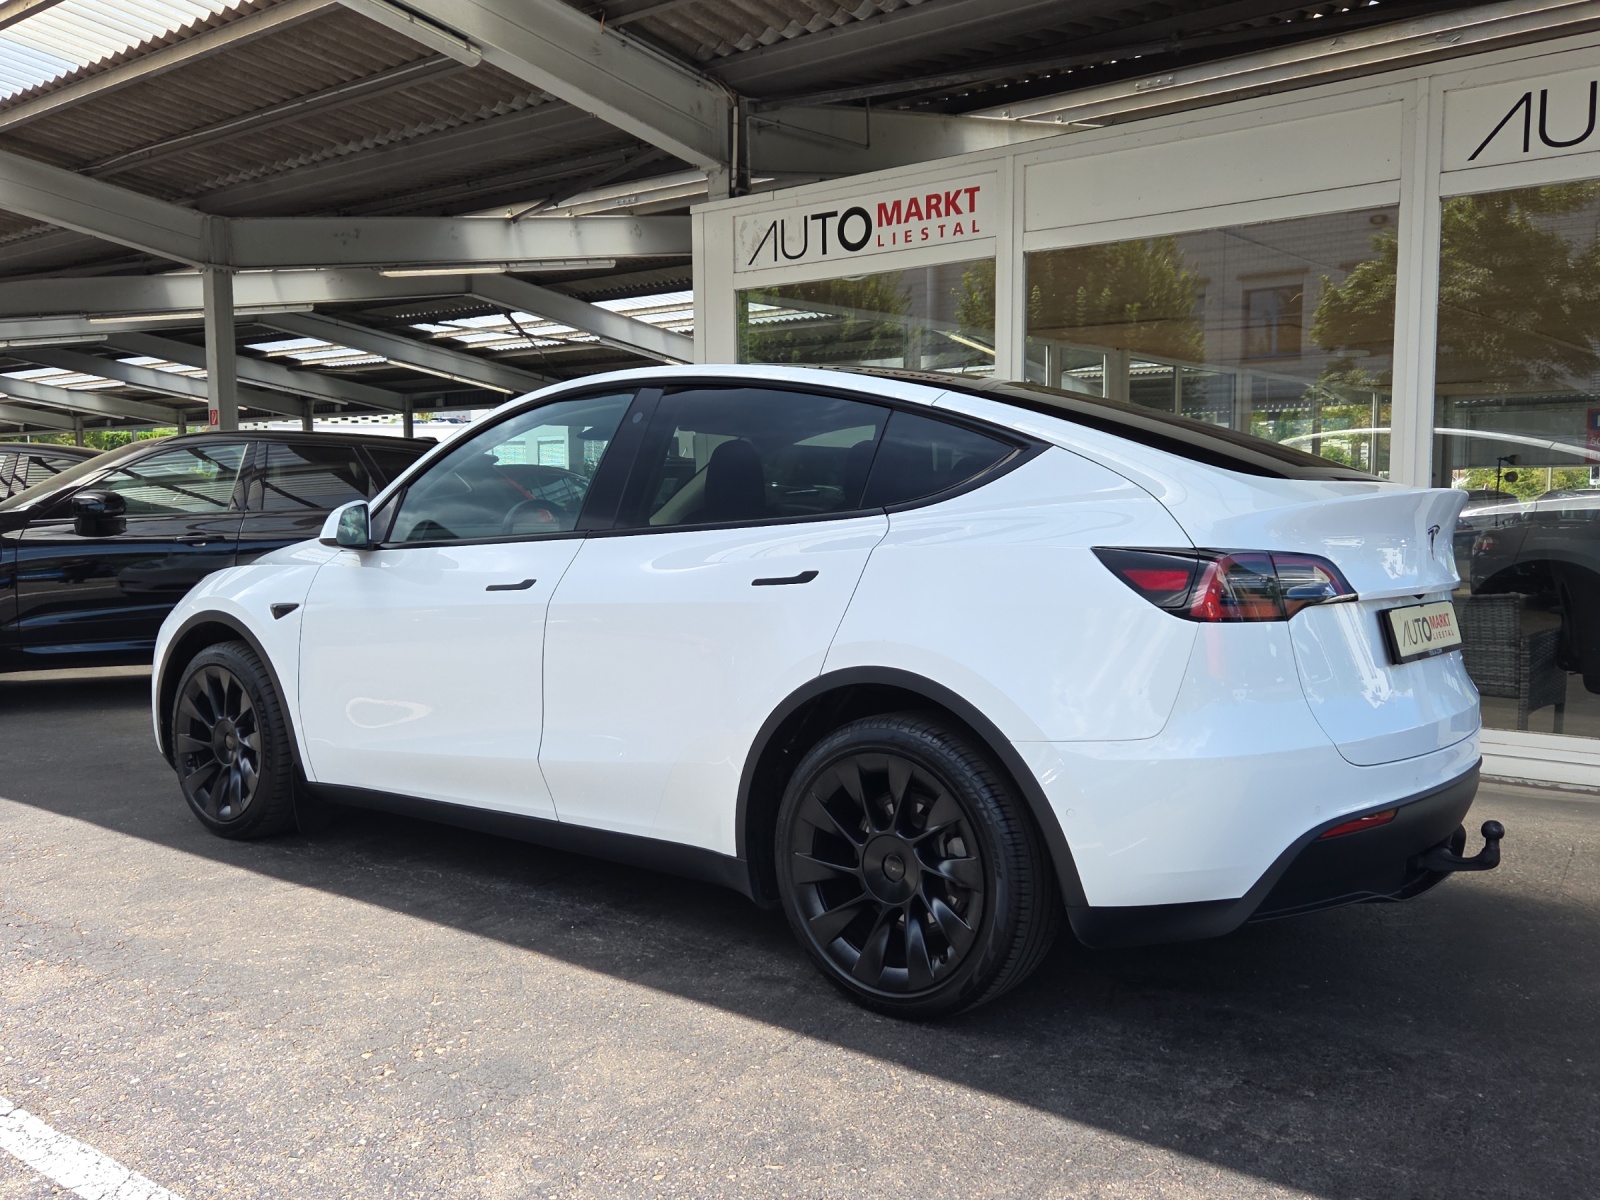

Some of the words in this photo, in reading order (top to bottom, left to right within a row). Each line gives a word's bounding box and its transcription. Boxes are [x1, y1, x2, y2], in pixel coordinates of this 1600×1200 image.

[748, 206, 872, 265] AUTO
[877, 186, 980, 228] MARKT
[877, 219, 980, 248] LIESTAL
[1403, 616, 1432, 647] AUTO
[1428, 612, 1451, 629] MARKT
[1433, 629, 1454, 640] LIESTAL
